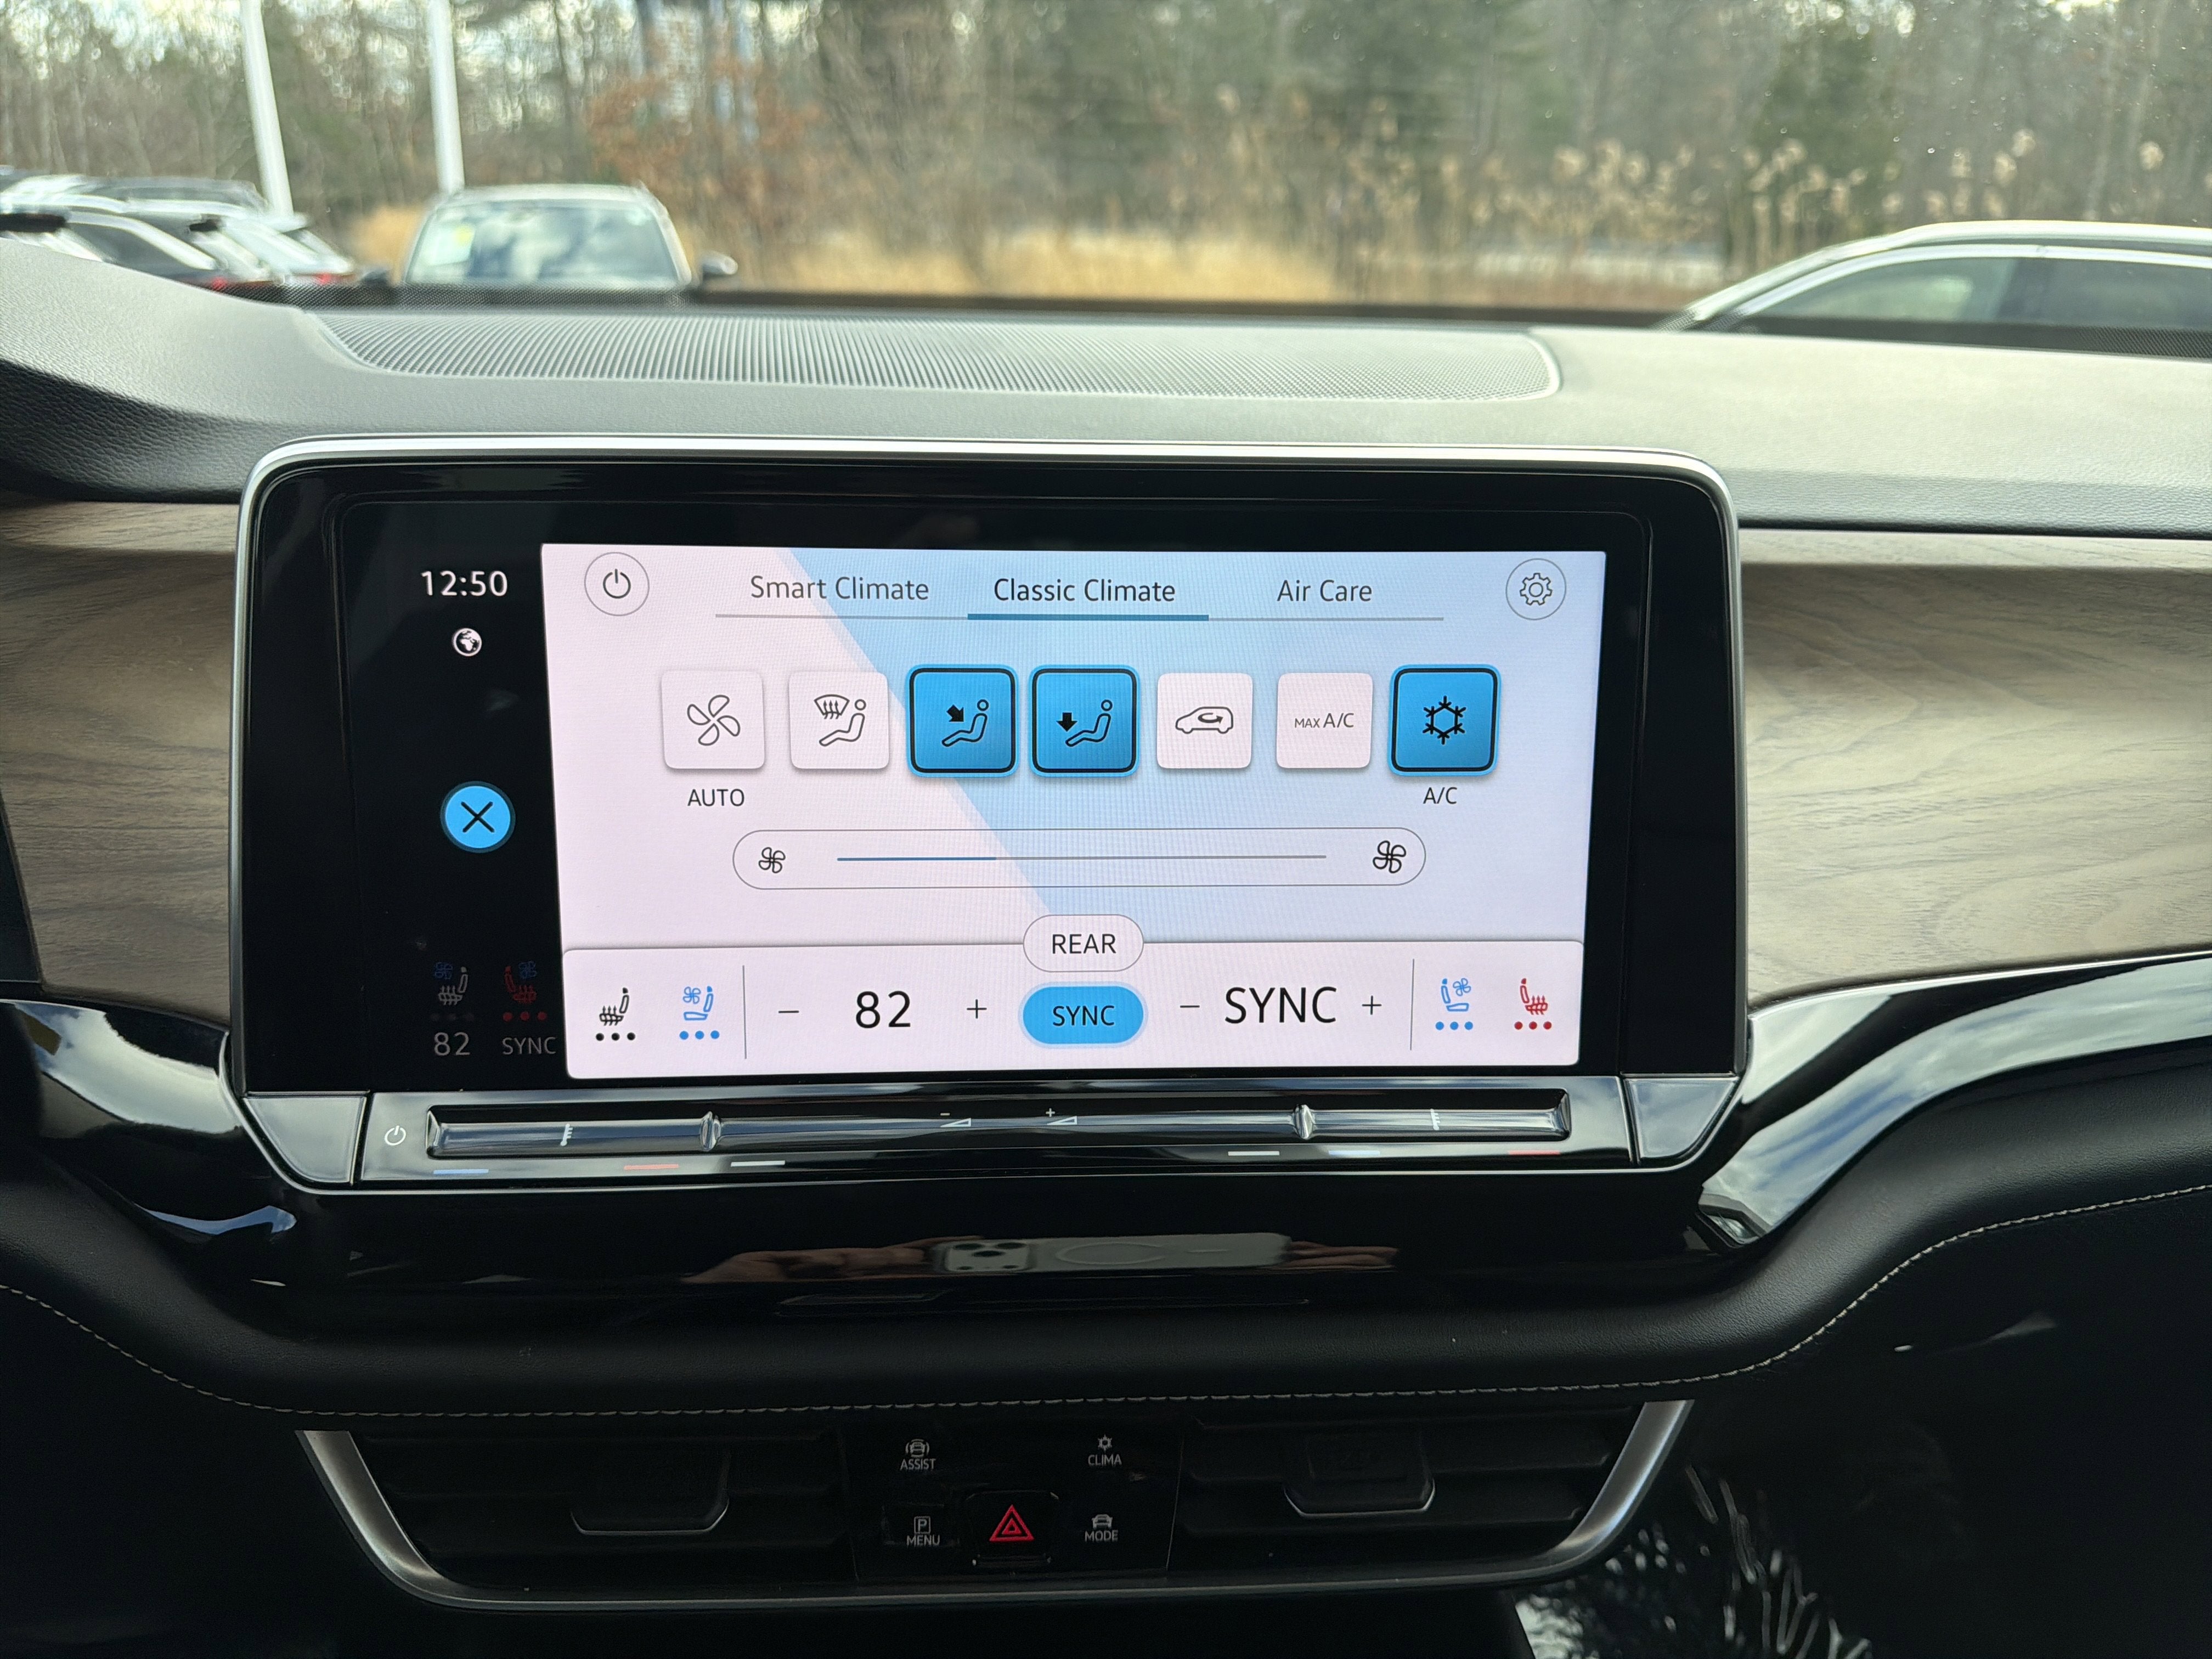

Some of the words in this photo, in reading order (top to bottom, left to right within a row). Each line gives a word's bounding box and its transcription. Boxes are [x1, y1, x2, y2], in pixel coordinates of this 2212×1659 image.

[421, 570, 507, 596] 12:50
[751, 575, 827, 599] Smart
[835, 576, 929, 600] Climate
[994, 578, 1075, 601] Classic
[1084, 578, 1175, 602] Climate
[1277, 579, 1311, 601] Air
[1320, 579, 1372, 602] Care
[1294, 718, 1321, 728] MAX
[1323, 713, 1354, 728] A/C
[687, 788, 745, 807] AUTO
[1423, 787, 1458, 805] A/C
[1052, 933, 1116, 954] REAR
[855, 990, 911, 1029] 82
[1053, 1005, 1114, 1026] SYNC
[1224, 986, 1337, 1024] SYNC
[434, 1032, 470, 1056] 82
[502, 1036, 556, 1055] SYNC
[900, 1458, 936, 1470] ASSIST
[1088, 1454, 1122, 1466] CLIMA
[906, 1534, 940, 1545] MENU
[1085, 1530, 1118, 1542] MODE
